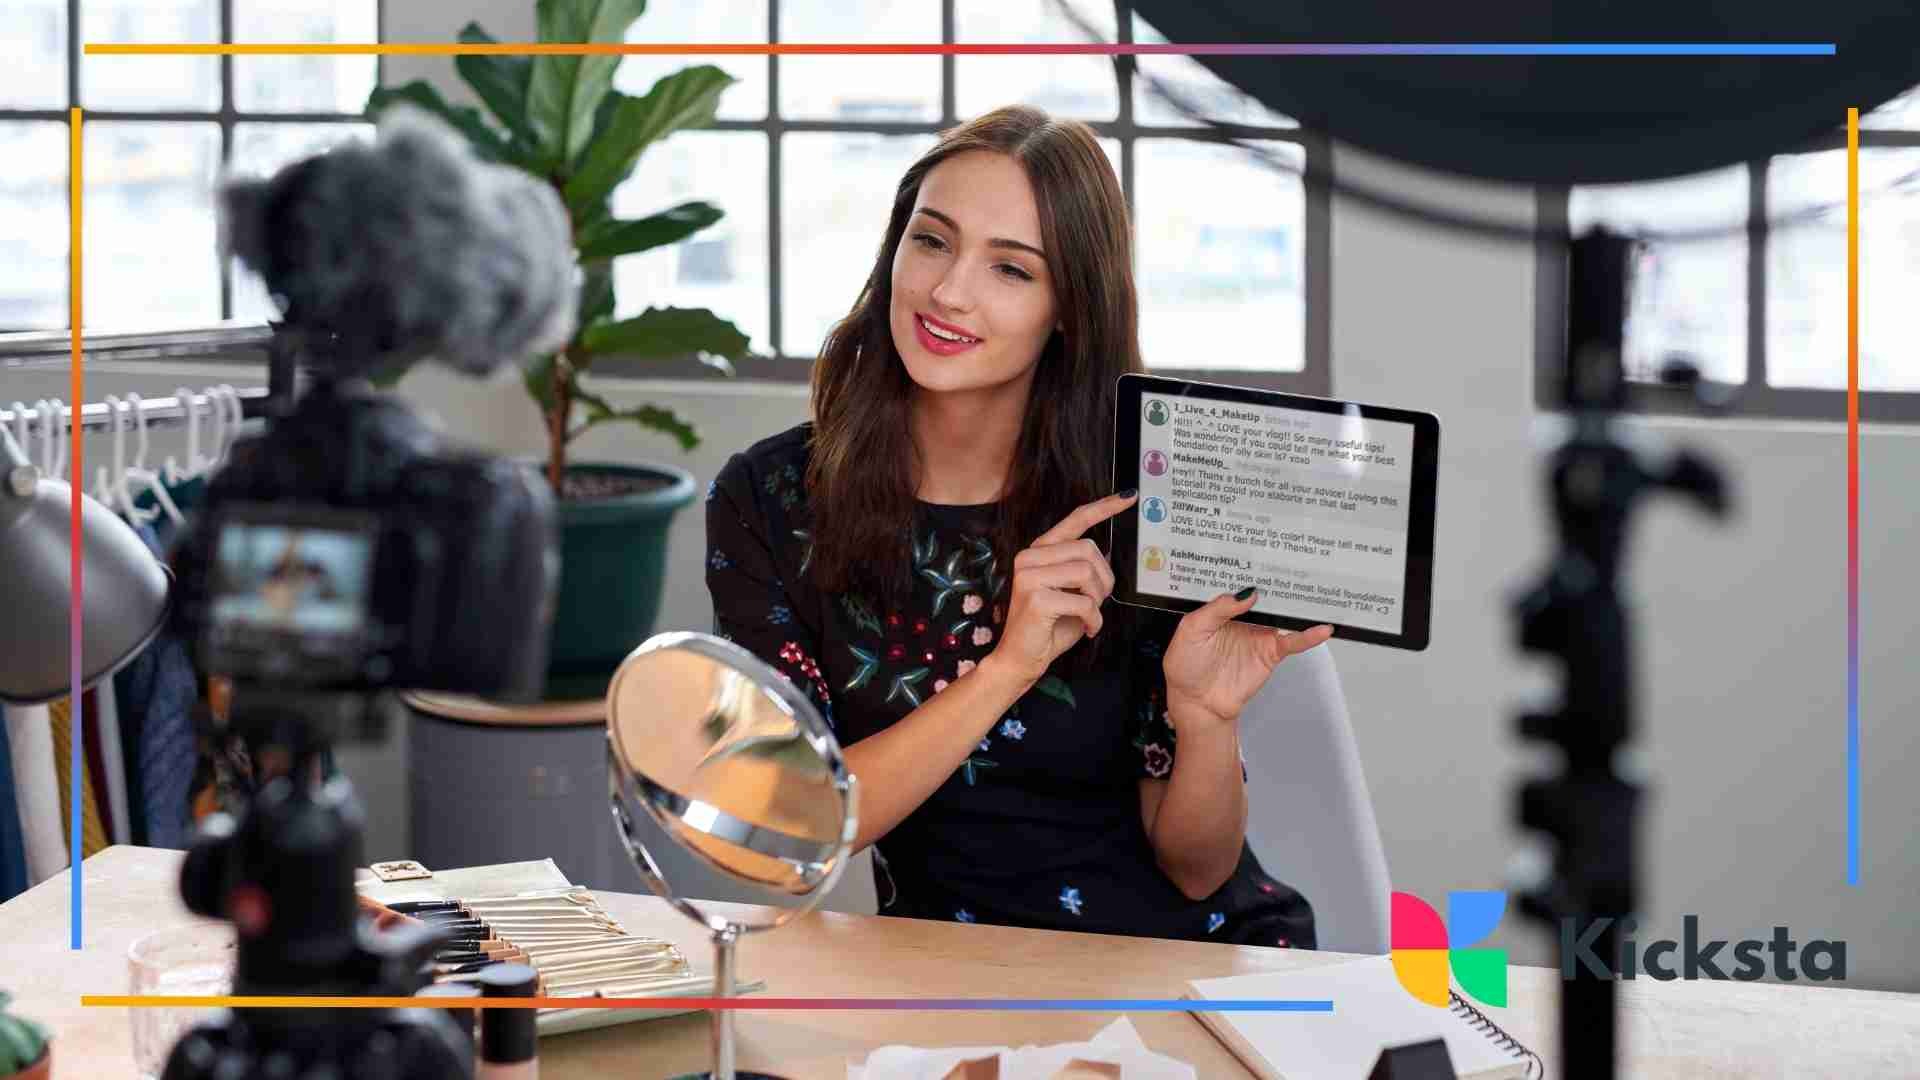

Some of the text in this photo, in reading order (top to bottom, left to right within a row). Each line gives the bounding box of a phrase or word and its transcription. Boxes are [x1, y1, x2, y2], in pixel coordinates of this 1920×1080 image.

[1174, 402, 1259, 423] I_Live_4_MakeUp
[1173, 437, 1310, 464] foundation for oily skin is? xoxo
[1174, 427, 1395, 465] Was wondering if you could tell me what your best
[1217, 423, 1240, 433] LOVE
[1243, 427, 1262, 438] your
[1266, 429, 1290, 441] vlog!!
[1294, 433, 1304, 441] So
[1307, 436, 1331, 447] many
[1335, 437, 1361, 449] useful
[1364, 441, 1385, 453] tips!
[1172, 452, 1229, 469] MakeMeUp_
[1171, 487, 1236, 504] application tip?
[1172, 466, 1195, 478] Hey!!
[1234, 475, 1260, 486] bunch
[1263, 479, 1275, 488] for
[1279, 481, 1288, 490] all
[1292, 485, 1311, 496] your
[1315, 487, 1345, 498] advice!
[1348, 492, 1377, 504] Loving
[1380, 495, 1398, 505] this
[1172, 477, 1205, 489] tutorial!!
[1208, 482, 1220, 491] Pls
[1223, 484, 1246, 495] could
[1249, 489, 1264, 499] you
[1305, 497, 1316, 505] on
[1319, 498, 1336, 508] that
[1340, 500, 1356, 511] last
[1171, 515, 1392, 555] LOVE LOVE LOVE your lip color! Please tell me what
[1171, 524, 1195, 536] shade
[1198, 528, 1223, 540] where
[1233, 535, 1247, 544] can
[1249, 536, 1266, 546] find
[1269, 539, 1280, 548] it?
[1283, 541, 1316, 554] Thanks!
[1170, 549, 1250, 570] AshMurrayMUA_1
[1169, 572, 1191, 583] leave
[1194, 577, 1205, 586] my
[1208, 578, 1226, 588] skin
[1271, 588, 1351, 609] recommendations?
[1376, 605, 1388, 614] <3
[1170, 562, 1395, 605] I have very dry skin and find most liquid foundations
